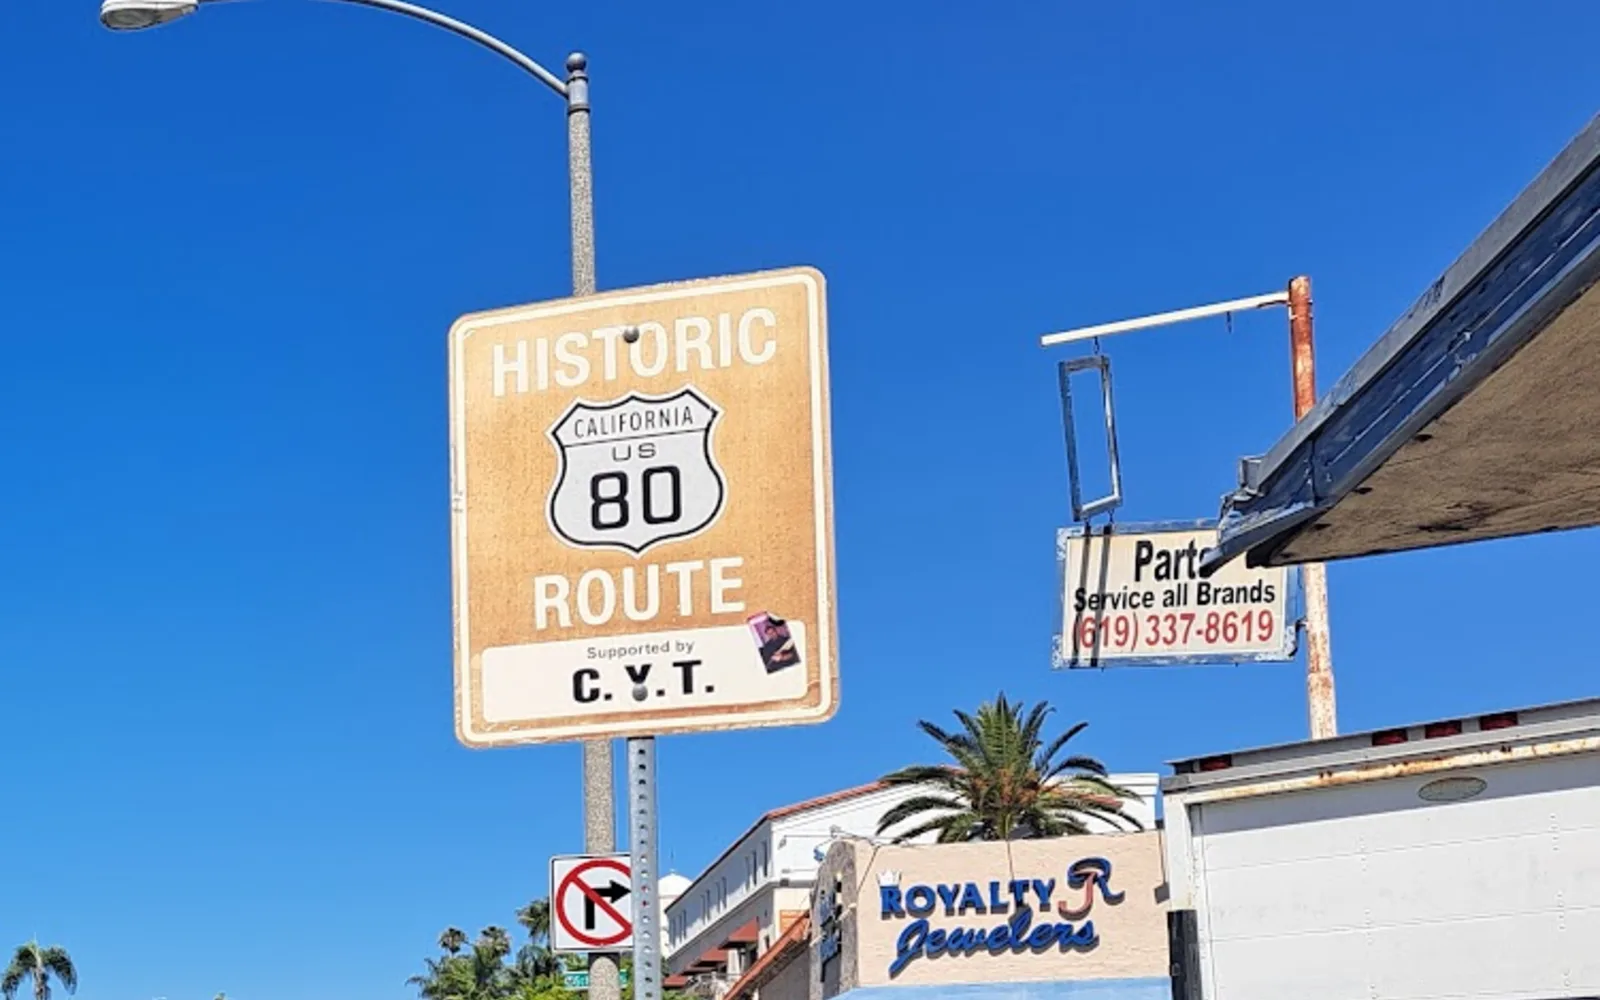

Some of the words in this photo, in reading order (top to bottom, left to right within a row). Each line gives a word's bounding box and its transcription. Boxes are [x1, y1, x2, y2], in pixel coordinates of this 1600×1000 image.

[492, 307, 777, 397] HISTORIC
[574, 406, 694, 438] CALIFORNIA
[612, 442, 657, 461] US
[590, 465, 682, 531] 80
[533, 556, 747, 630] ROUTE
[1074, 585, 1155, 612] Service
[1162, 583, 1188, 607] all
[1197, 579, 1275, 606] Brands
[587, 641, 670, 660] Supported
[675, 640, 695, 655] by
[1073, 612, 1139, 652] (619)
[1145, 609, 1274, 646] 337-8619
[880, 879, 1056, 918] ROYALTY
[889, 905, 1099, 977] Jewelers
